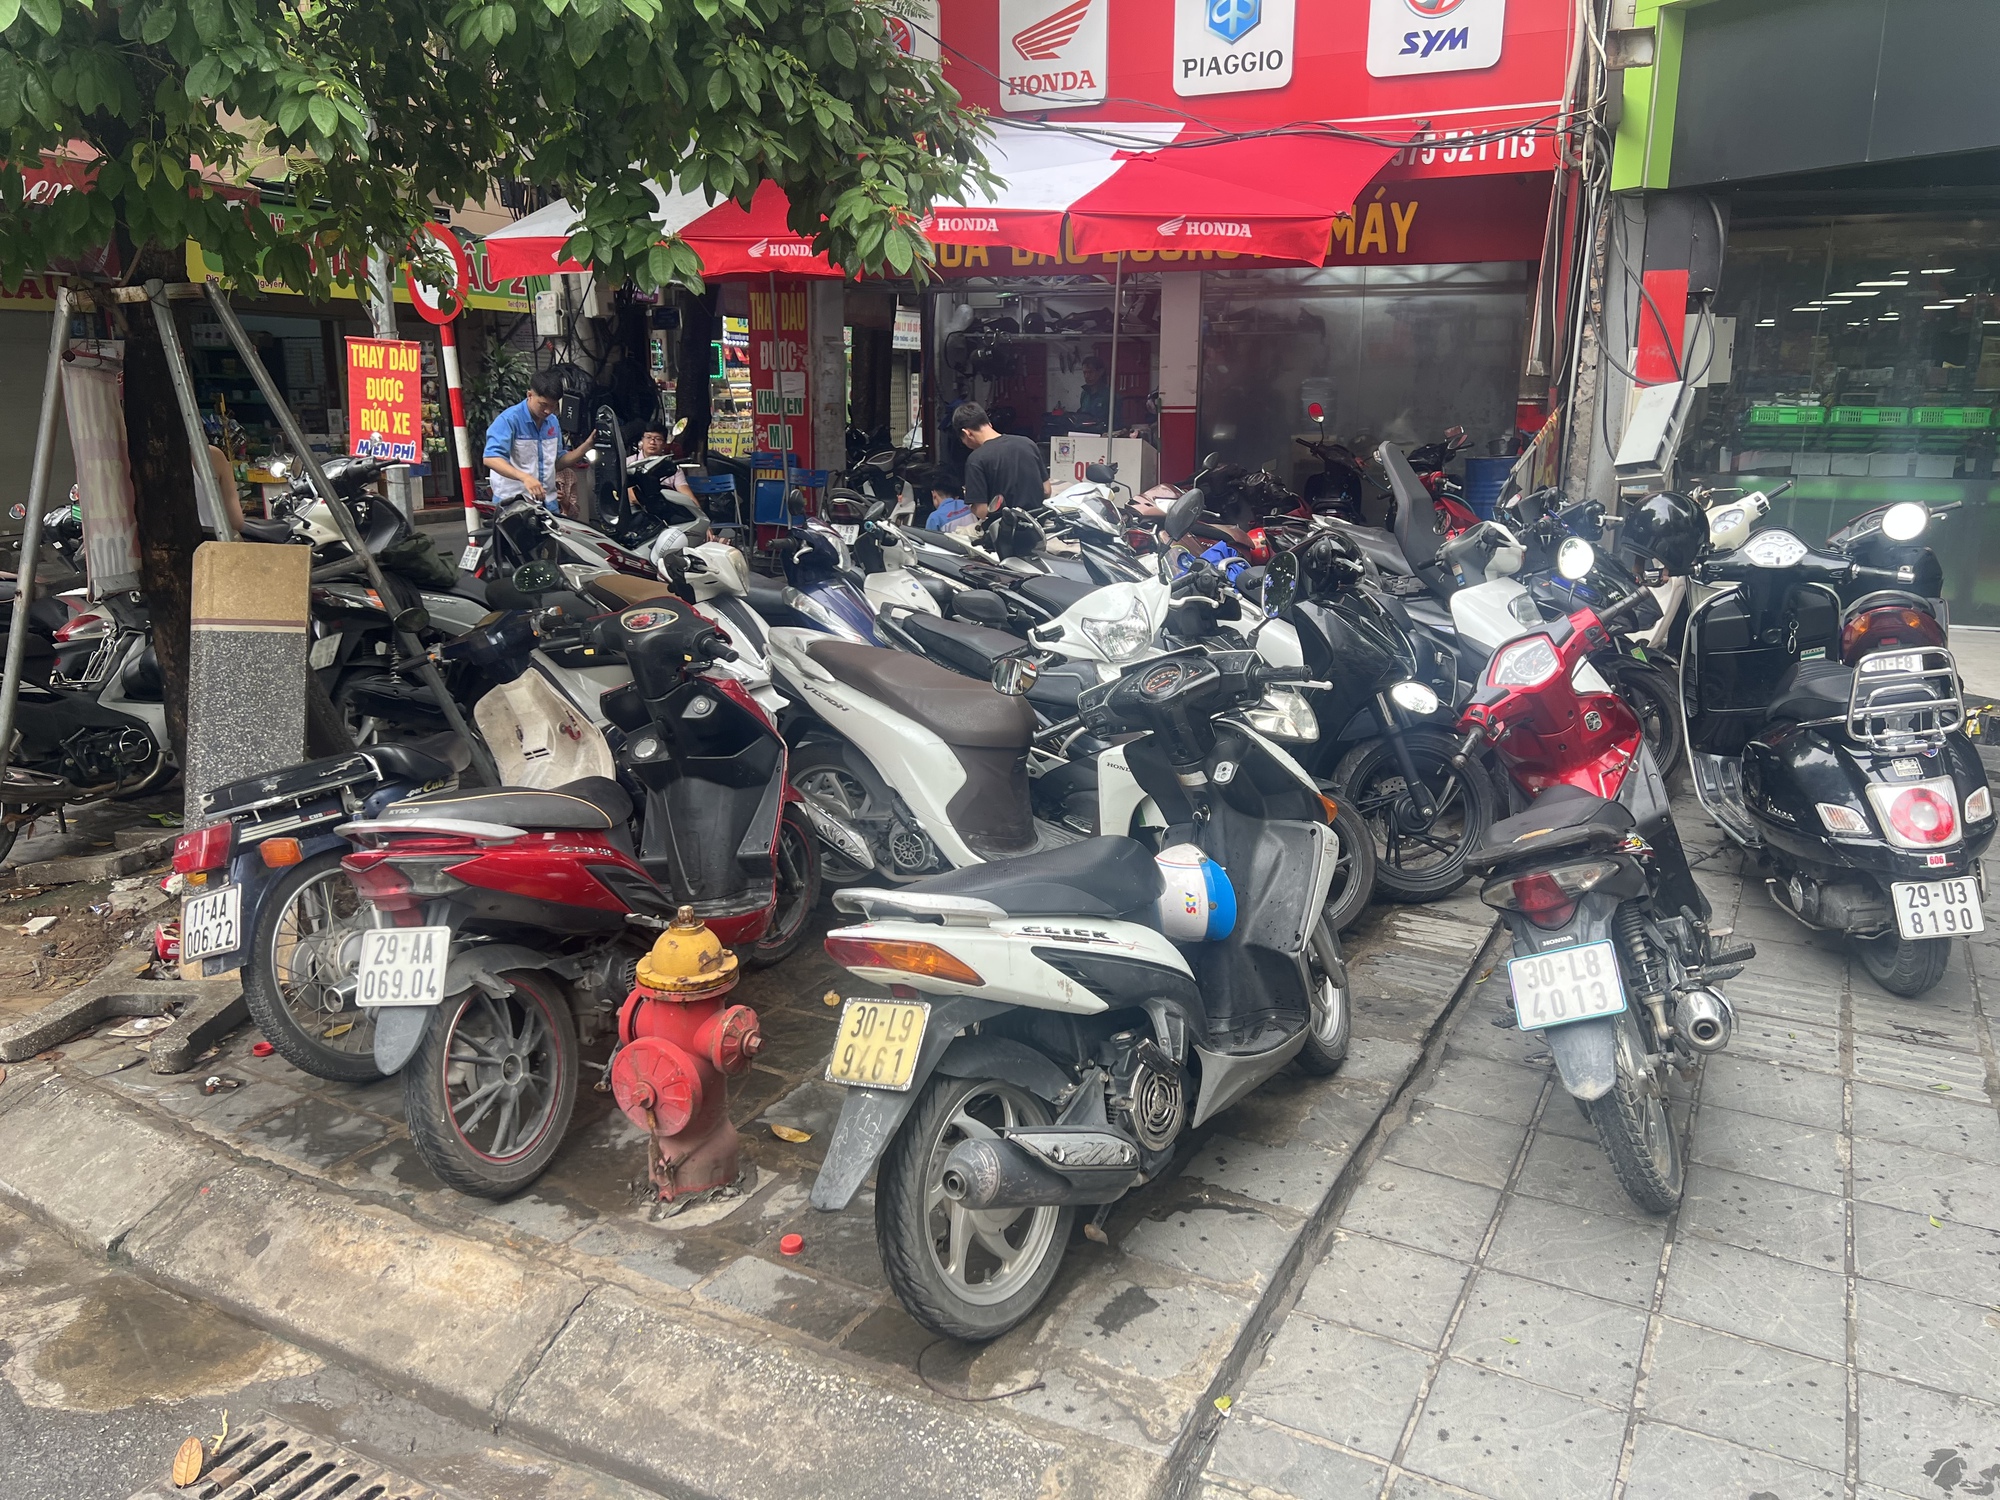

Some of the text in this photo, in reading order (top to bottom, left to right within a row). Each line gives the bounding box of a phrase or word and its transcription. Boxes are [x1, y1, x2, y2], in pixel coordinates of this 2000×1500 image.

[1398, 27, 1469, 58] SYM
[1182, 49, 1283, 79] PIAGGIO
[1008, 70, 1096, 96] HONDA
[936, 217, 999, 232] HONDA
[1185, 221, 1252, 238] HONDA
[351, 341, 418, 372] THAY DẦU
[366, 377, 404, 407] ĐƯỢC
[360, 402, 411, 435] RỬA XE
[392, 441, 416, 459] PHÍ
[803, 682, 849, 711] VISION
[1107, 762, 1131, 772] HOND
[423, 780, 444, 792] Cub
[388, 807, 419, 815] KYMCO
[1929, 856, 1944, 866] 606
[193, 893, 227, 926] 11-AA
[1905, 882, 1967, 908] 29-U3
[1021, 925, 1109, 939] CLICK
[1911, 907, 1973, 934] 8190
[187, 920, 234, 957] 006.22
[1542, 935, 1573, 946] HONDA
[1523, 949, 1601, 989] 30-L8
[364, 968, 437, 1000] 069.04
[1533, 981, 1608, 1021] 4013
[850, 1005, 915, 1043] 30-L9
[840, 1043, 904, 1083] 9461
